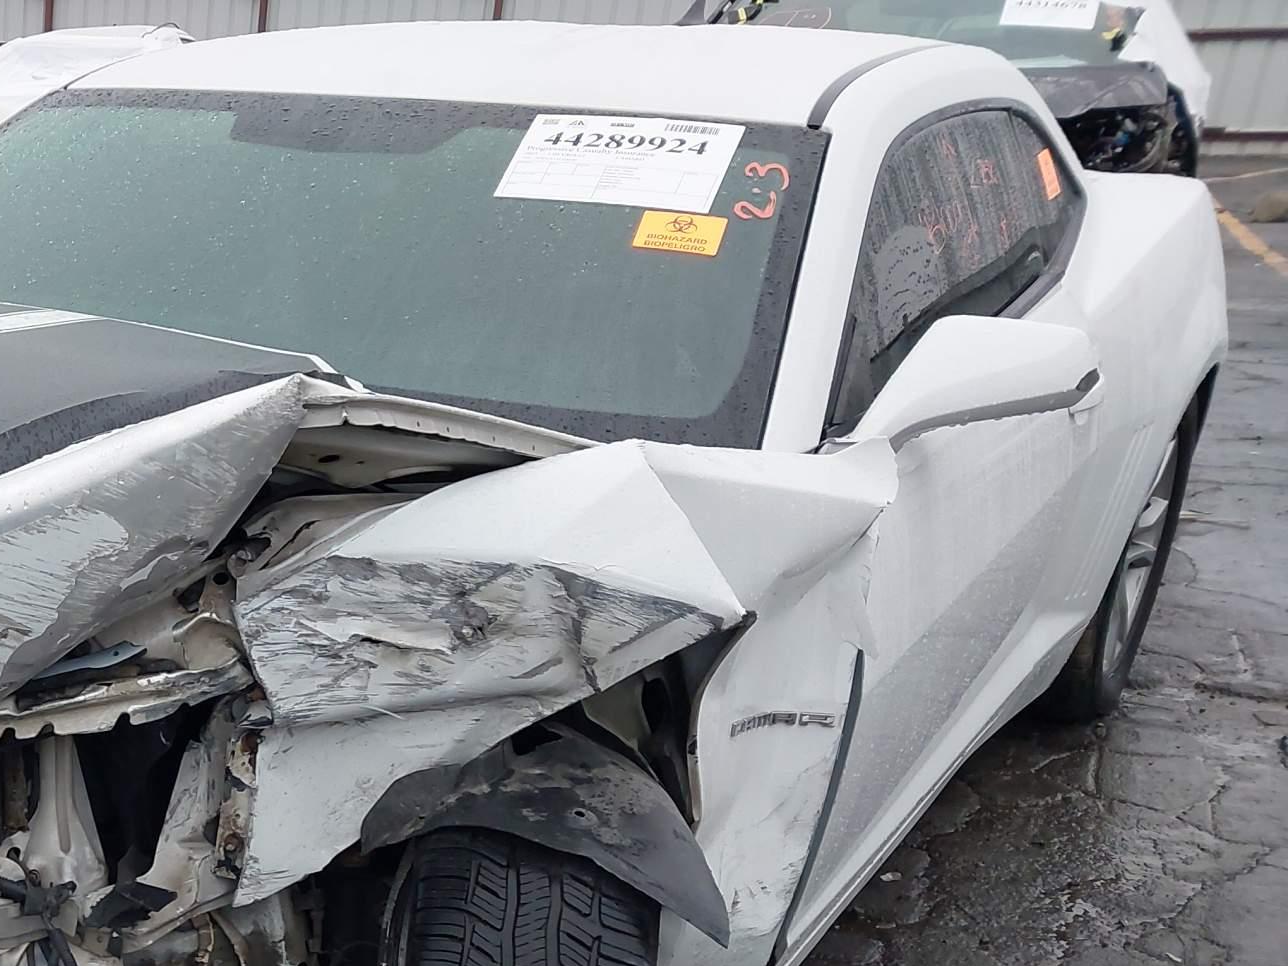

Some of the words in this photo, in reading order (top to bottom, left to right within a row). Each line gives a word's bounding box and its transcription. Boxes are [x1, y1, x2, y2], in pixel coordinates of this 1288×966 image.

[543, 131, 710, 155] 44289924
[646, 233, 708, 245] BIOHAZARD
[643, 240, 706, 252] BIOPELIGRO
